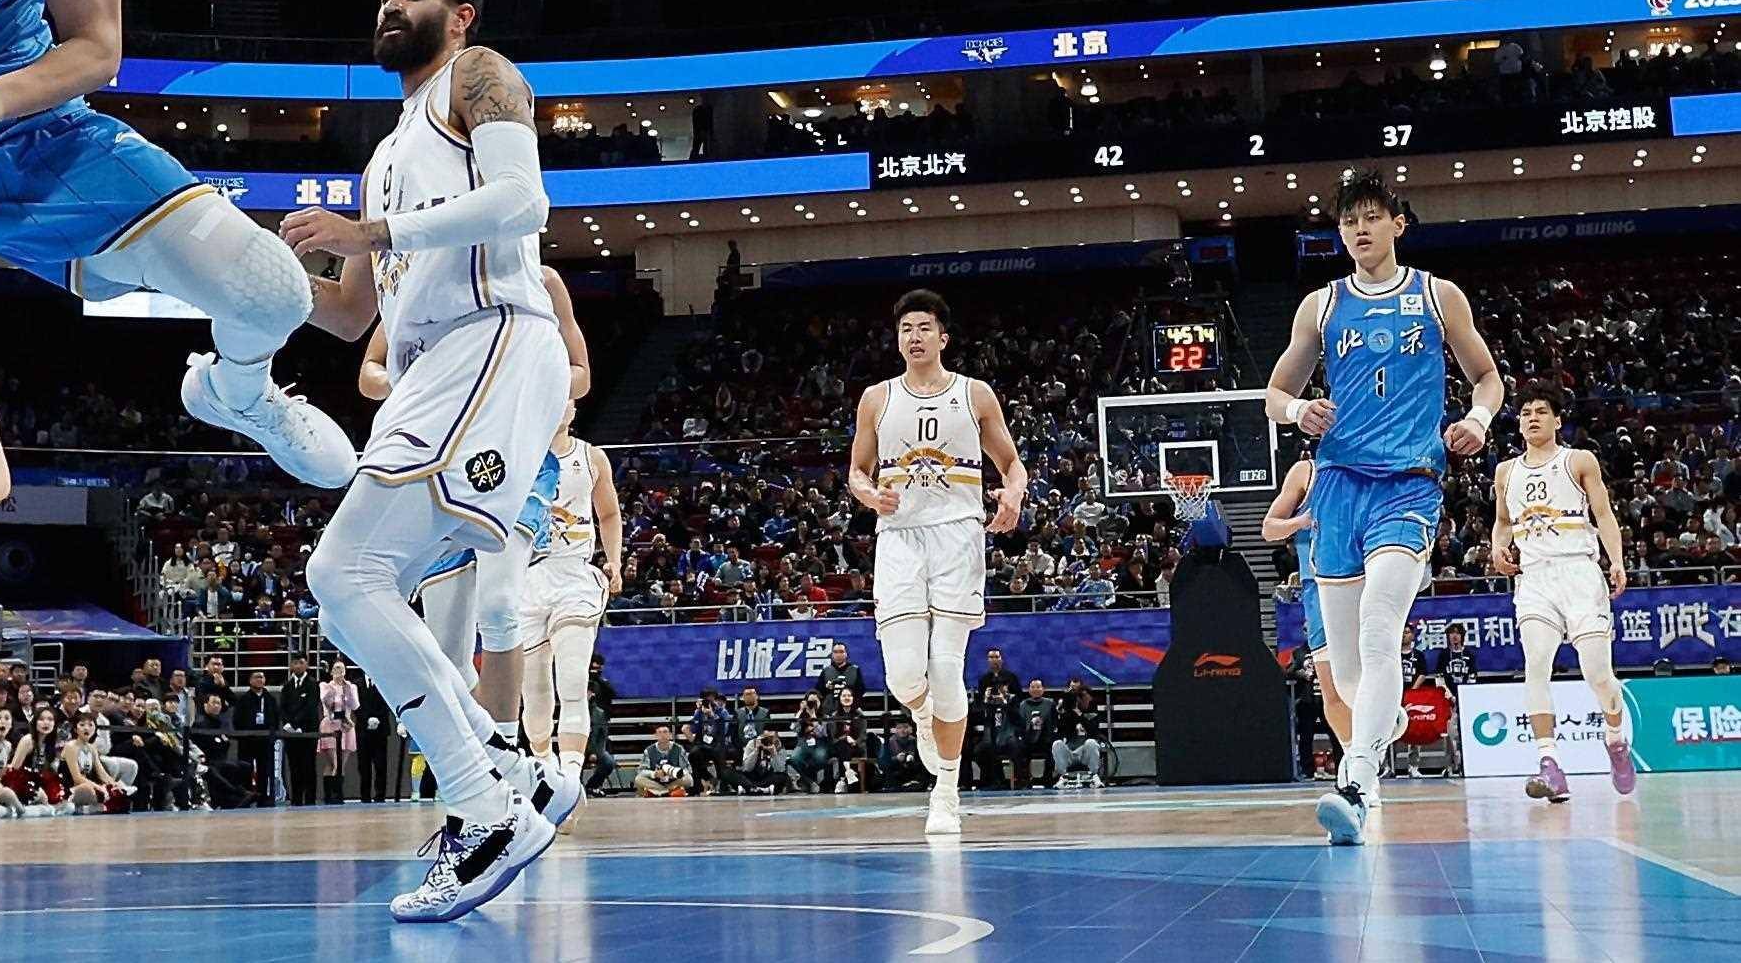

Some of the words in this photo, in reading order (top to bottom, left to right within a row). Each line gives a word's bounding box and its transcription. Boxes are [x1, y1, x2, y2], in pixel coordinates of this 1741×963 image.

[1052, 30, 1109, 58] 北京
[877, 152, 967, 179] 北京北汽
[1094, 145, 1124, 167] 42
[1249, 134, 1265, 156] 2
[1383, 124, 1413, 148] 37
[1560, 106, 1657, 135] 北京控股
[296, 178, 353, 205] 北京
[382, 164, 393, 212] 9
[1170, 347, 1203, 369] 22
[918, 417, 939, 442] 10
[1525, 481, 1548, 503] 23
[716, 635, 834, 680] 以城之名
[1515, 711, 1605, 732] 中人寿
[1671, 706, 1741, 741] 保险
[1572, 731, 1606, 741] LIFE
